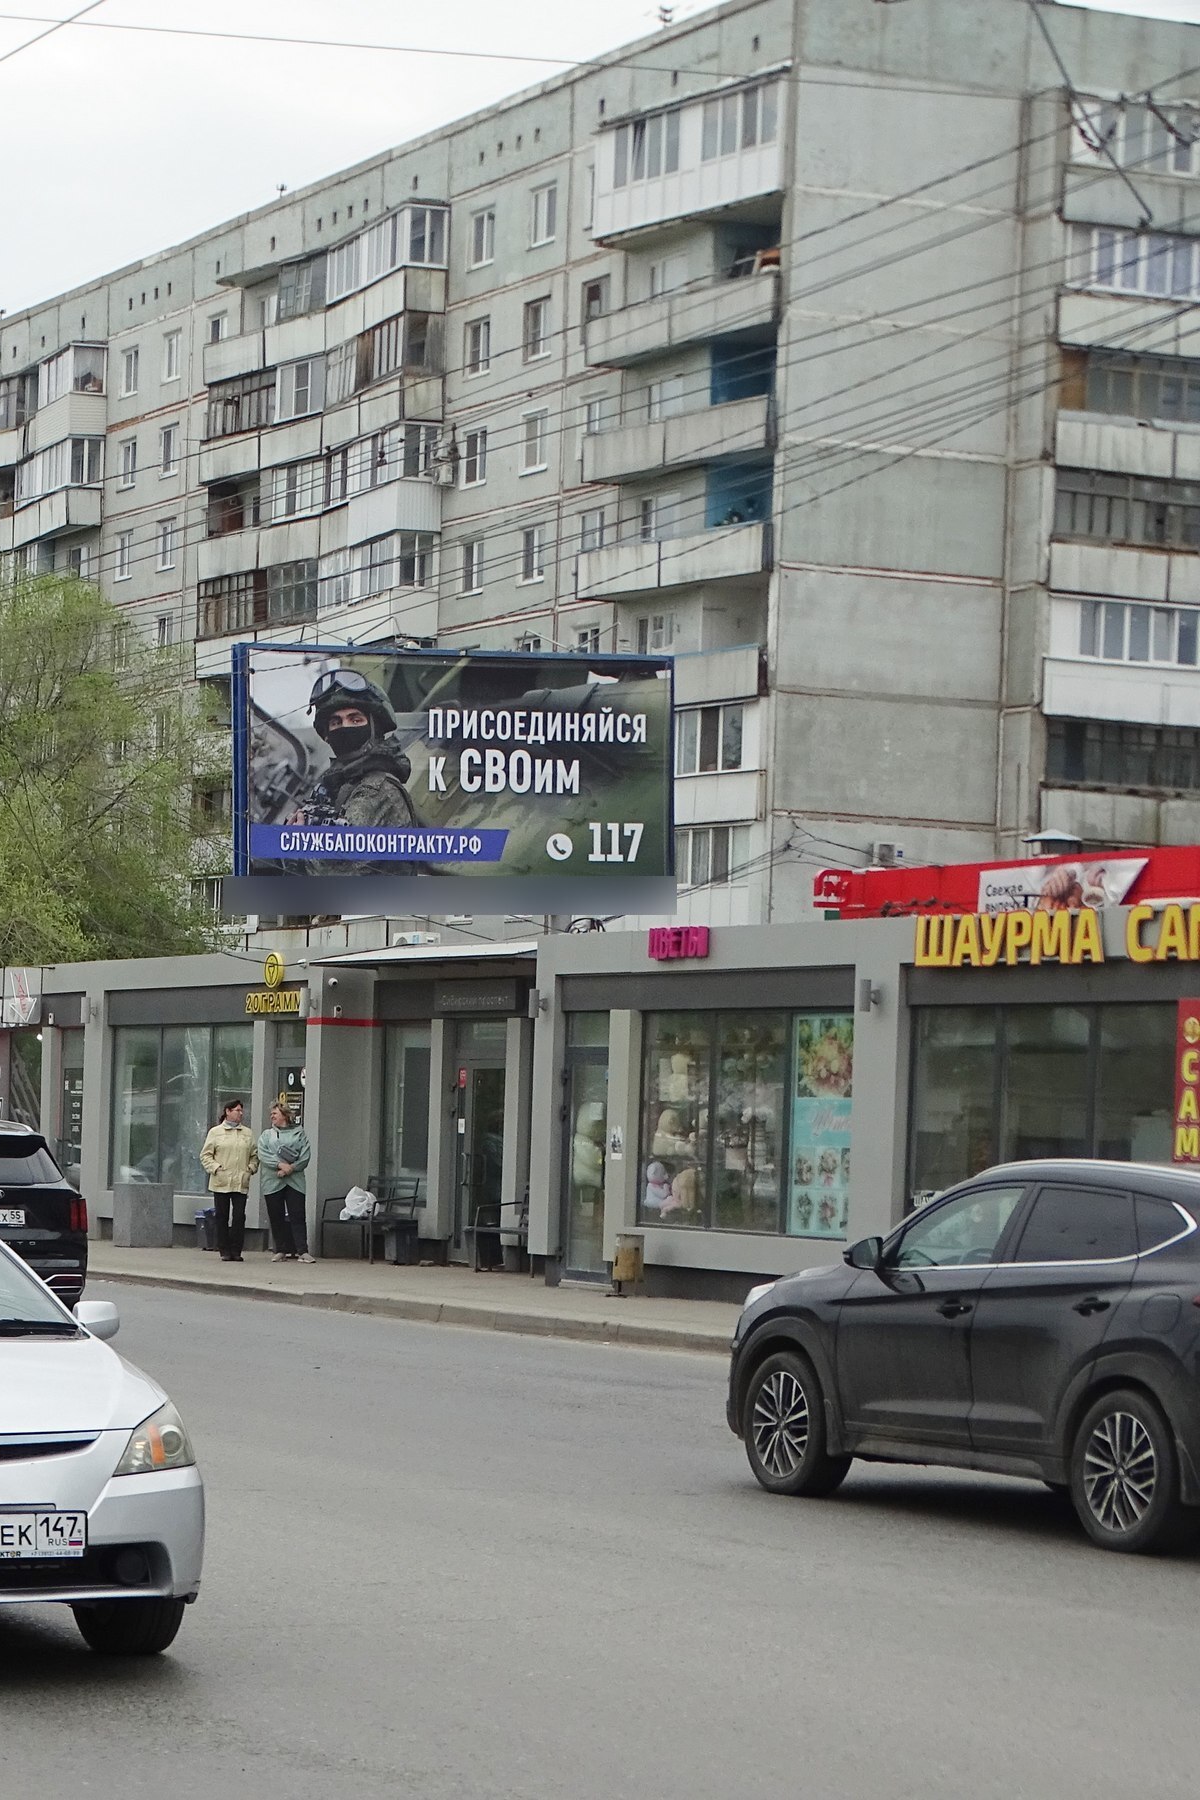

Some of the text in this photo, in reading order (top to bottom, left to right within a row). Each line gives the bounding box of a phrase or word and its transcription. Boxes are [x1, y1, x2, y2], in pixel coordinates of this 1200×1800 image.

[428, 707, 647, 745] ПРИСОЕДИНЯЙСЯ
[280, 831, 482, 855] СЛУЖБАПОКОНТРАКТУ.РФ
[588, 822, 644, 862] 117
[649, 926, 710, 961] ЦВЕТЫ
[914, 907, 1104, 967] ШАУРМА
[10, 1210, 21, 1220] 55
[39, 1516, 79, 1538] 147
[47, 1538, 68, 1546] RUS
